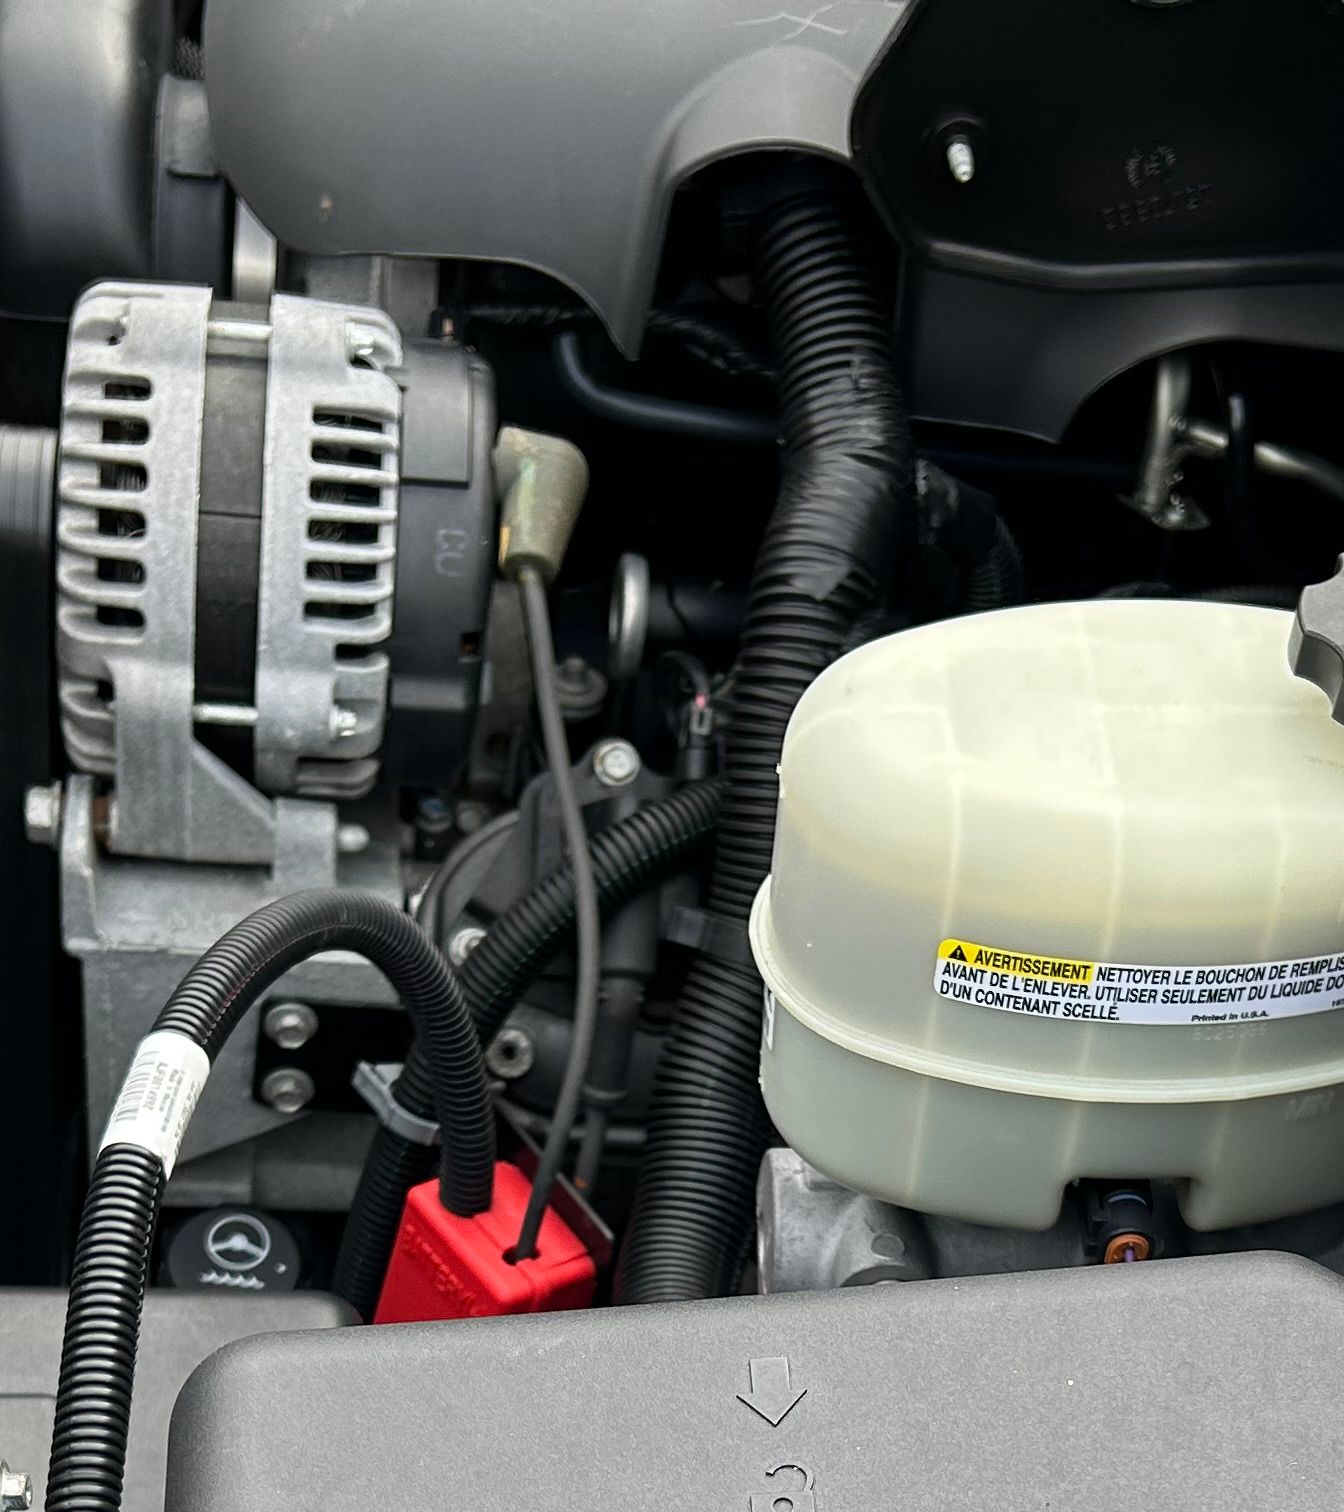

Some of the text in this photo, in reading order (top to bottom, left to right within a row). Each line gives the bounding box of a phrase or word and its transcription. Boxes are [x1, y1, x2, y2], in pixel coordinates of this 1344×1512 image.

[942, 961, 987, 985] AVANT
[989, 972, 1007, 989] DE
[1011, 976, 1091, 1000] L'ENLEVER.
[1095, 986, 1158, 1004] UTILISER
[1160, 987, 1246, 1004] SEULEMENT
[1248, 984, 1268, 1001] DU
[1270, 977, 1325, 999] LIQUIDE
[973, 948, 1091, 981] AVERTISSEMENT
[1095, 966, 1171, 985] NETTOYER
[1174, 969, 1193, 985] LE
[1195, 967, 1267, 985] BOUCHON
[1268, 964, 1287, 981] DE
[939, 980, 1120, 1021] D'UN CONTENANT SCELLÉ.
[1191, 1009, 1270, 1022] Printed in U.S.A.
